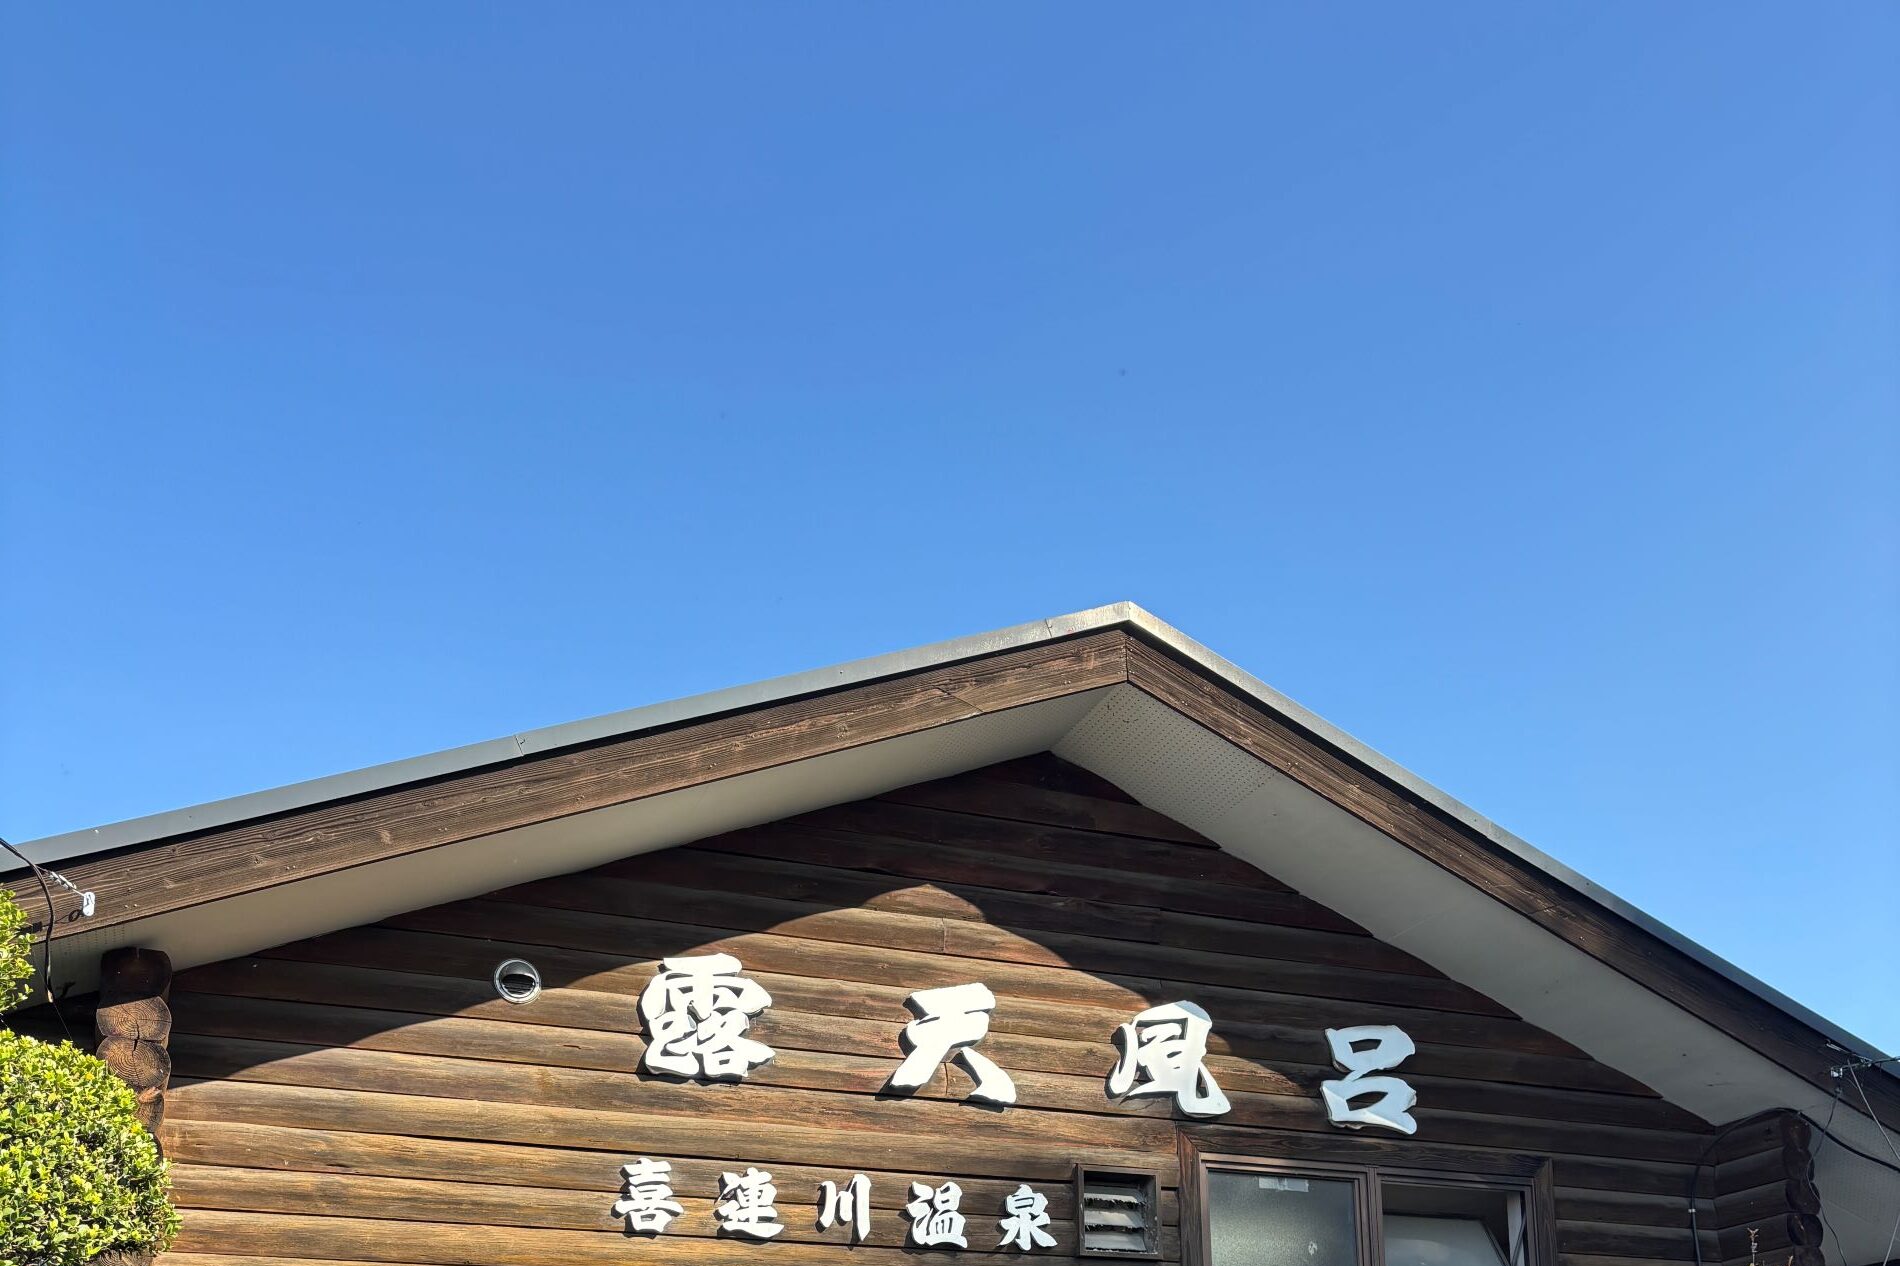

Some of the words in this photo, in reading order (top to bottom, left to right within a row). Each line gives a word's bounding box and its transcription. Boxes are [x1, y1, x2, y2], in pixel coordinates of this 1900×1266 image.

[642, 953, 1418, 1135] 露天風呂
[613, 1157, 1059, 1252] 喜連川温泉
